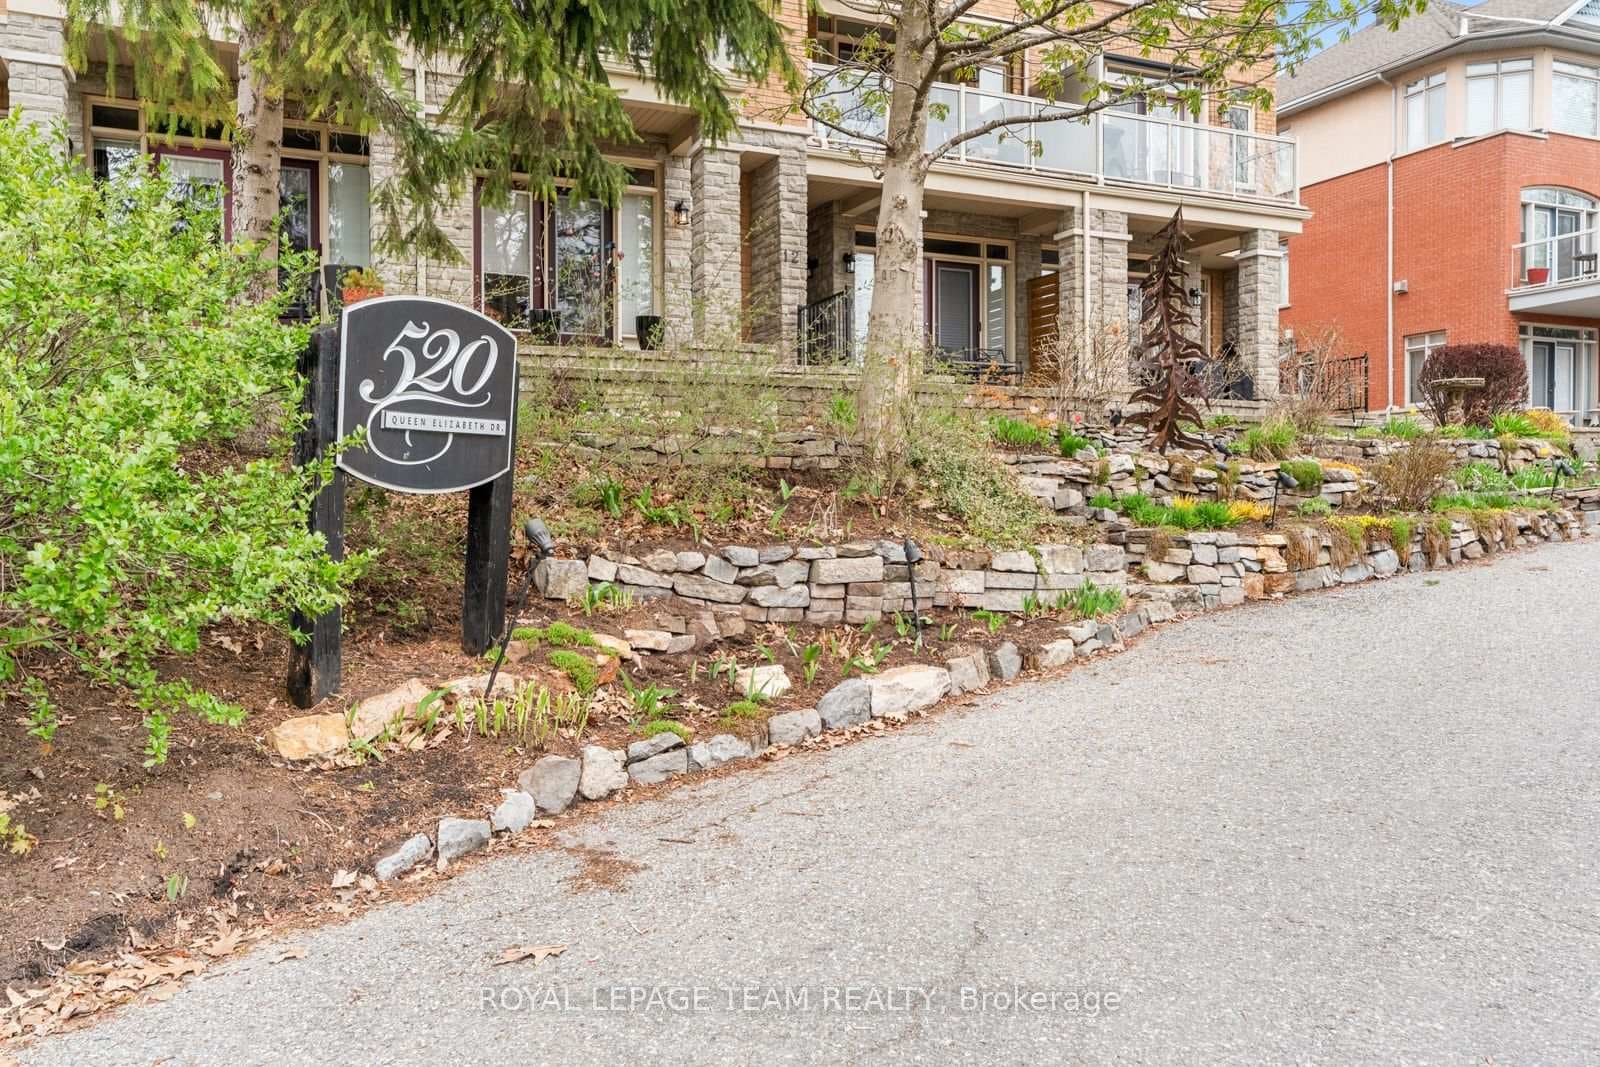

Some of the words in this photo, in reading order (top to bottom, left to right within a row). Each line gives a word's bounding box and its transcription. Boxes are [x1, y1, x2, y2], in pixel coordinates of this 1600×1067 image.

[784, 249, 799, 263] 12
[359, 320, 498, 404] 520
[391, 415, 426, 426] QUEEN
[432, 419, 485, 430] ELIZABETH
